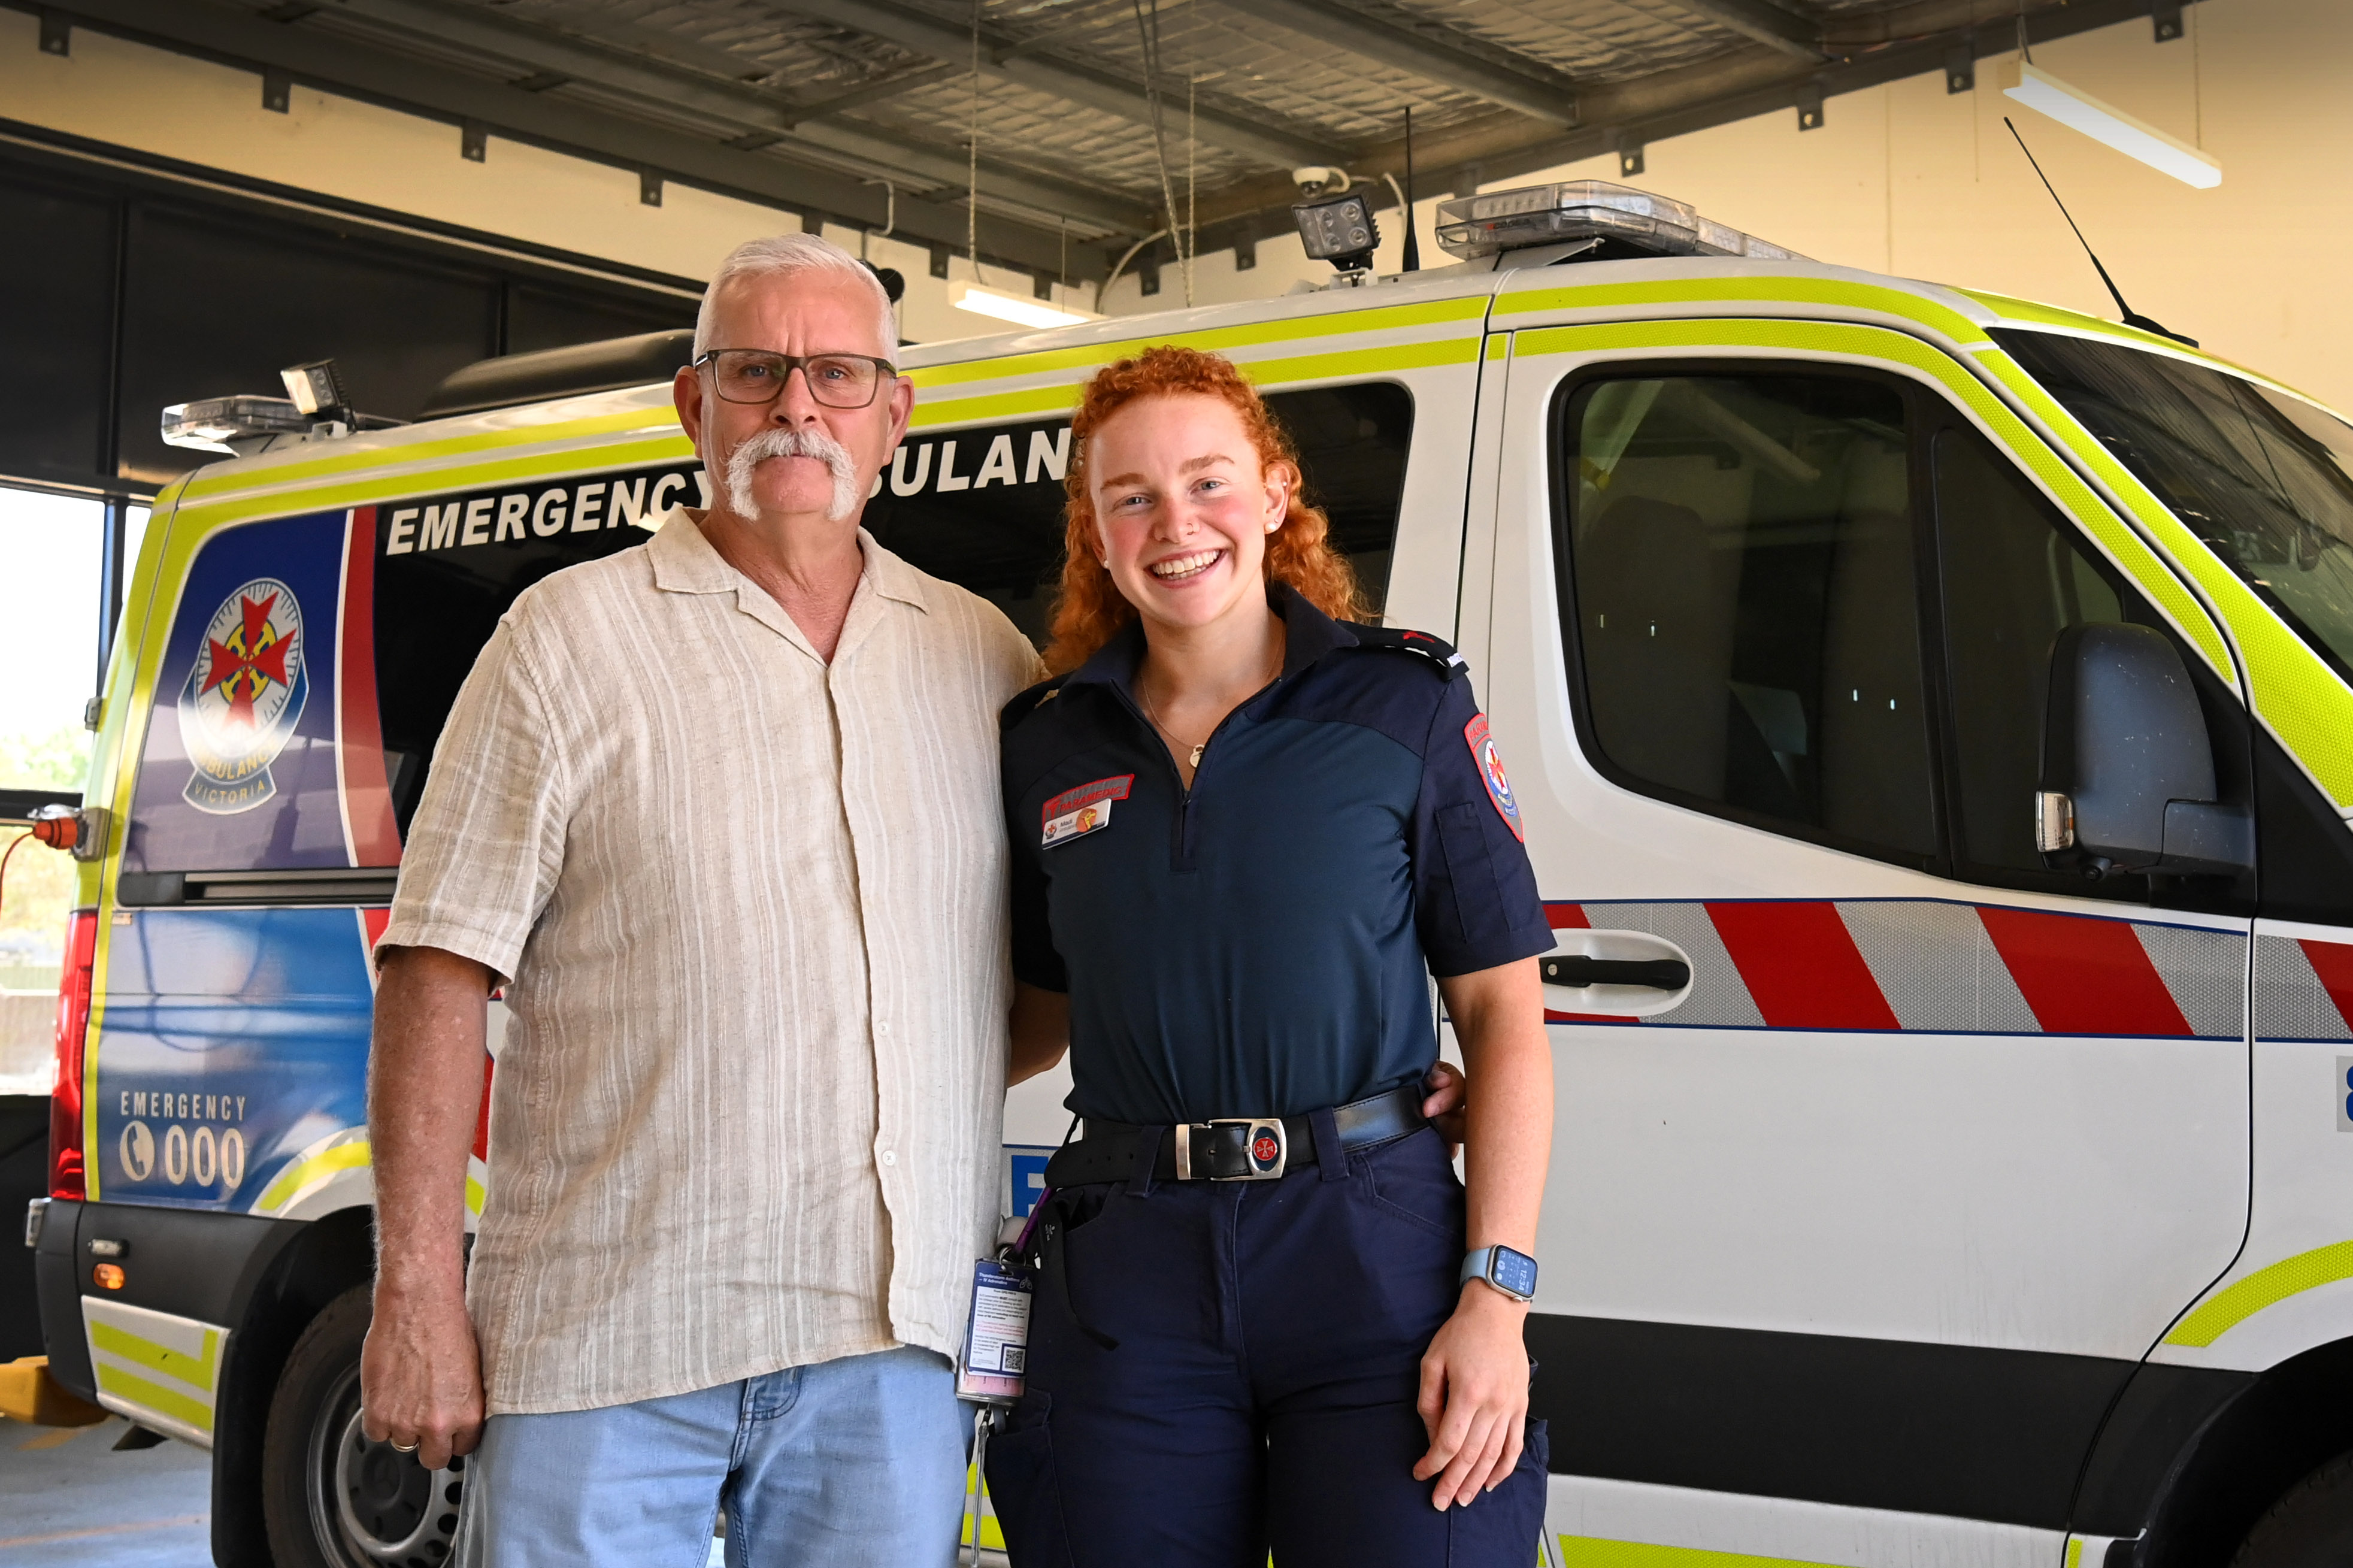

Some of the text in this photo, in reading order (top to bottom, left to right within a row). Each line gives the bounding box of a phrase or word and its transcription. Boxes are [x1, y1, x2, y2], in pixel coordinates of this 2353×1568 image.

[868, 427, 1072, 499] ULAN
[195, 780, 265, 803] VICTORIA
[1060, 786, 1122, 813] PARAMEDIC
[121, 1091, 246, 1121] EMERGENCY
[165, 1125, 244, 1188] 000
[1519, 1270, 1527, 1291] 12:34
